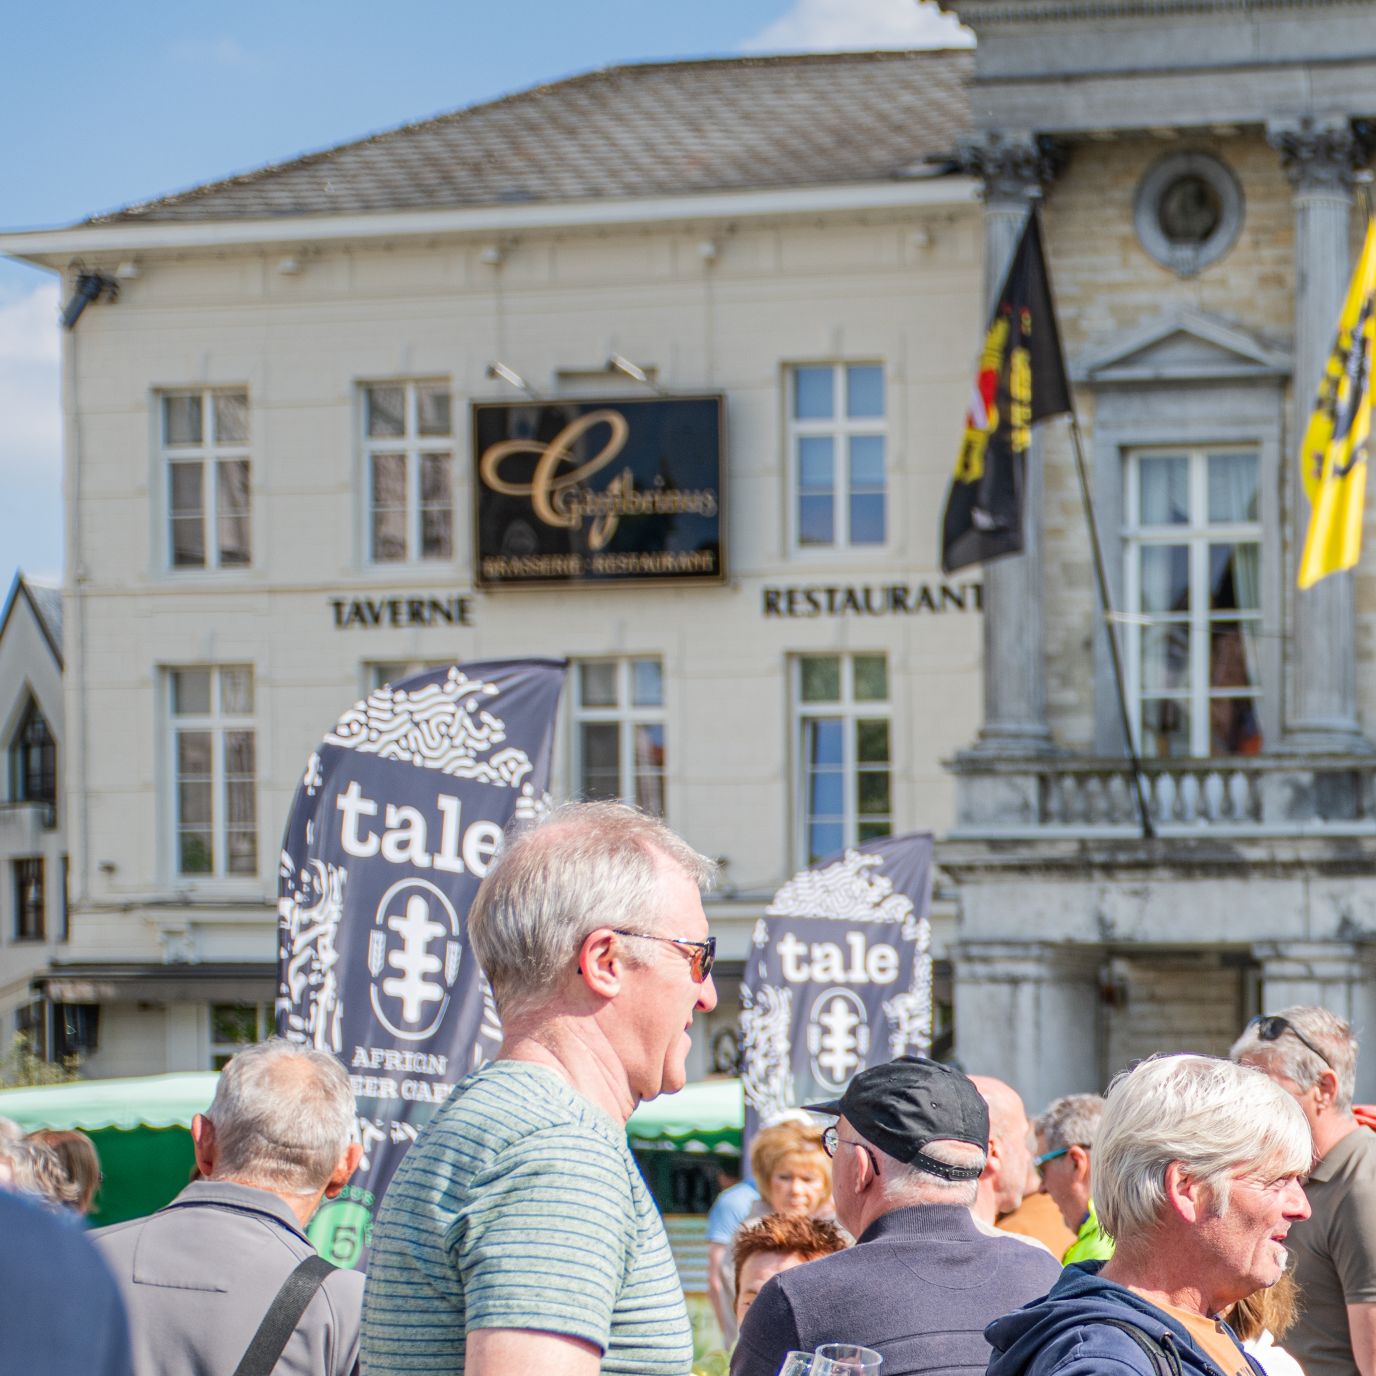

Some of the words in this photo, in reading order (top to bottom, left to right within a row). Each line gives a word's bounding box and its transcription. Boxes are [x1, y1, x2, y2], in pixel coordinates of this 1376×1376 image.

[328, 594, 475, 629] TAVERNE
[762, 583, 985, 618] RESTAURANT
[336, 780, 506, 879] tale
[776, 931, 899, 984] tale
[349, 1073, 399, 1099] EER
[401, 1078, 453, 1104] CAF
